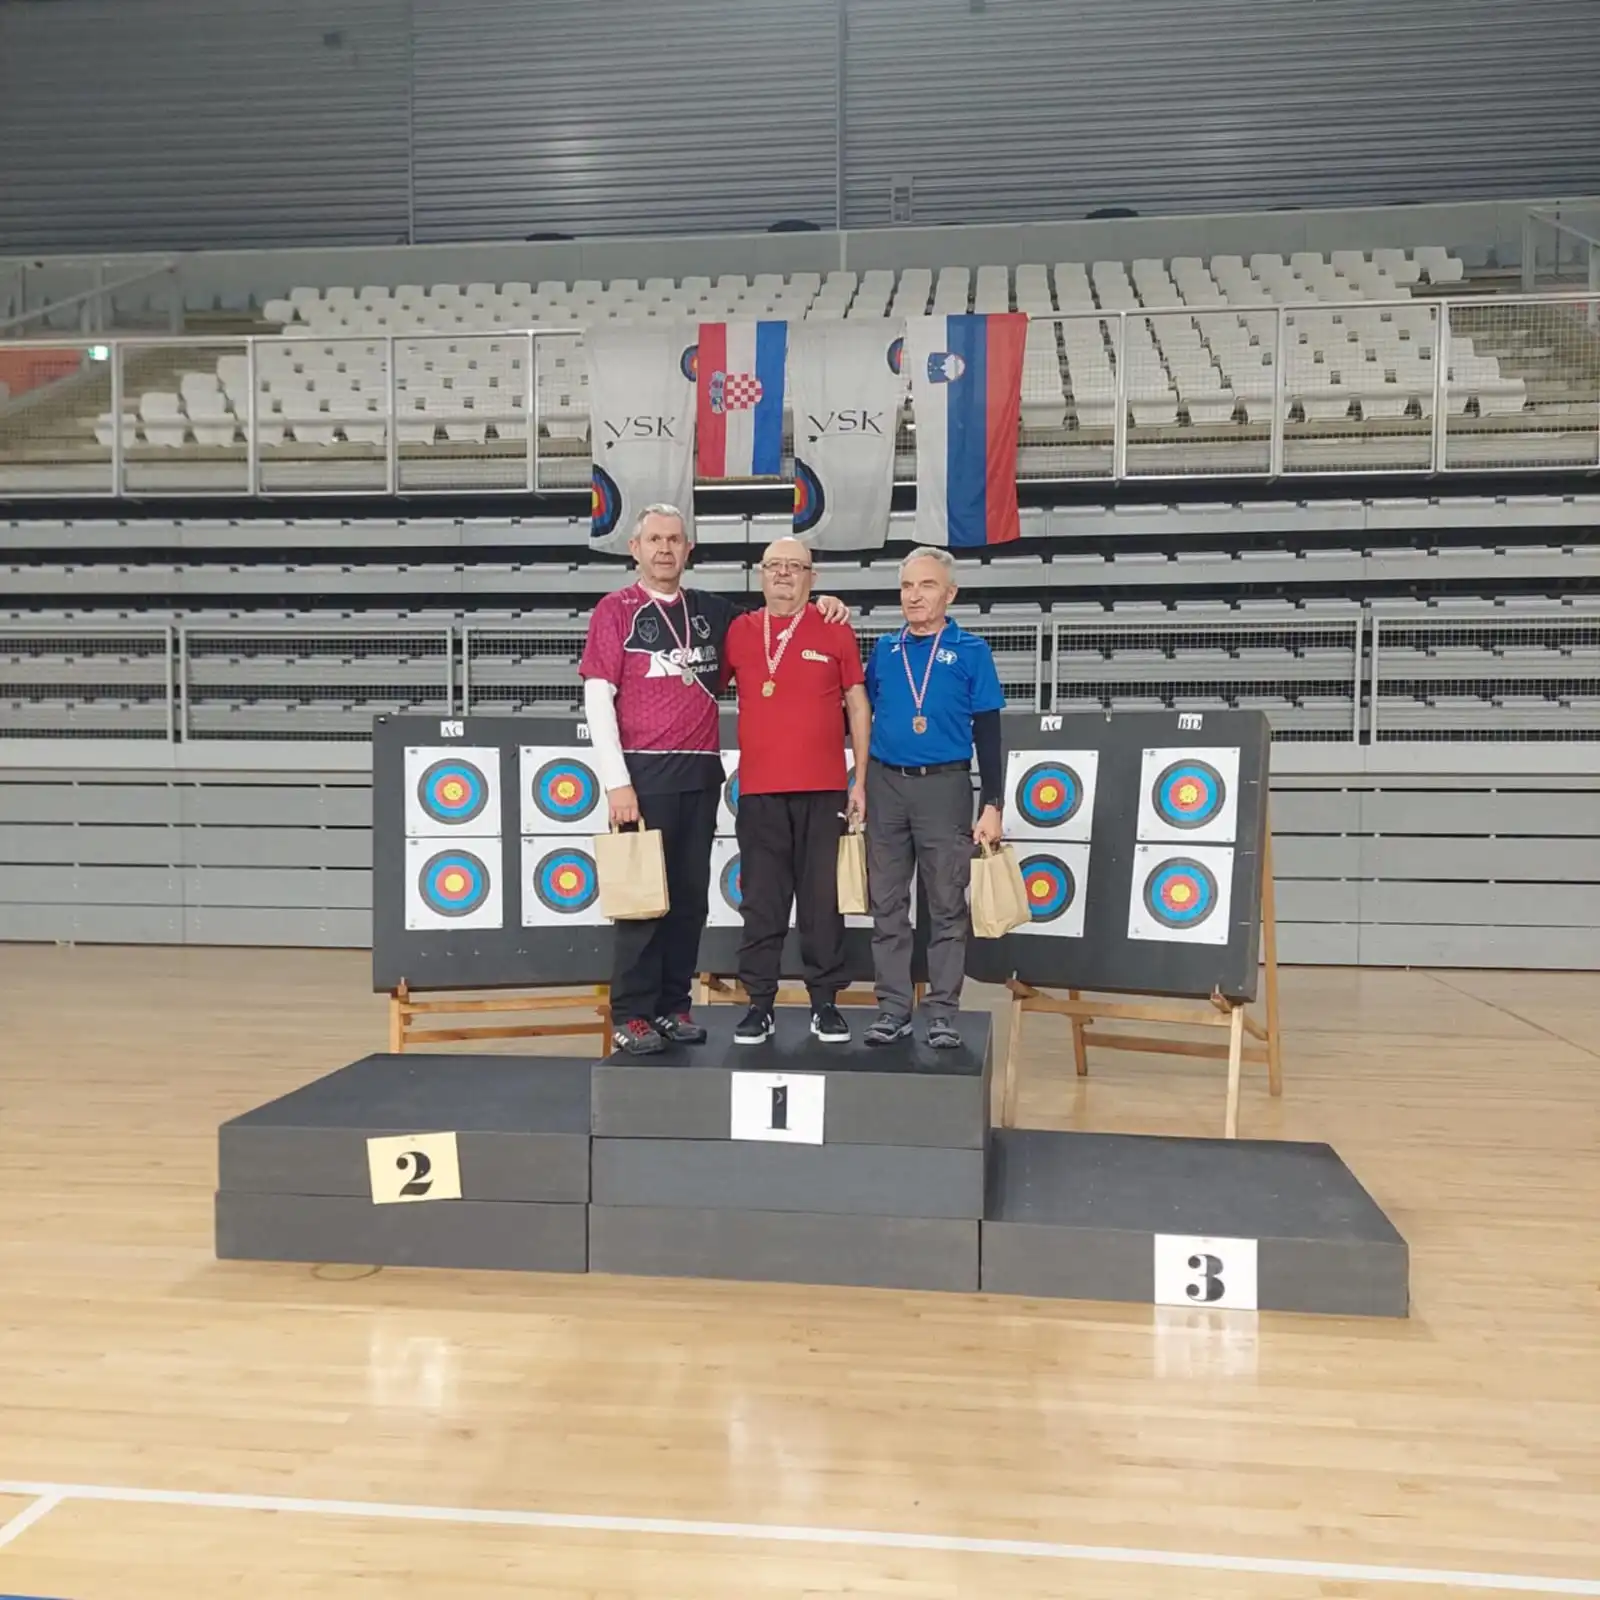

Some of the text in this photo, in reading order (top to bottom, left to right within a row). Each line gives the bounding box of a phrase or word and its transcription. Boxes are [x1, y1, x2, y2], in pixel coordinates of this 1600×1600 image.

[604, 416, 675, 438] VSK
[808, 410, 884, 434] VSK
[443, 725, 462, 737] AC
[578, 727, 588, 738] B
[1043, 719, 1061, 731] AC
[1180, 718, 1202, 729] BD
[766, 1084, 792, 1130] 1
[396, 1151, 434, 1198] 2
[1186, 1254, 1225, 1302] 3
